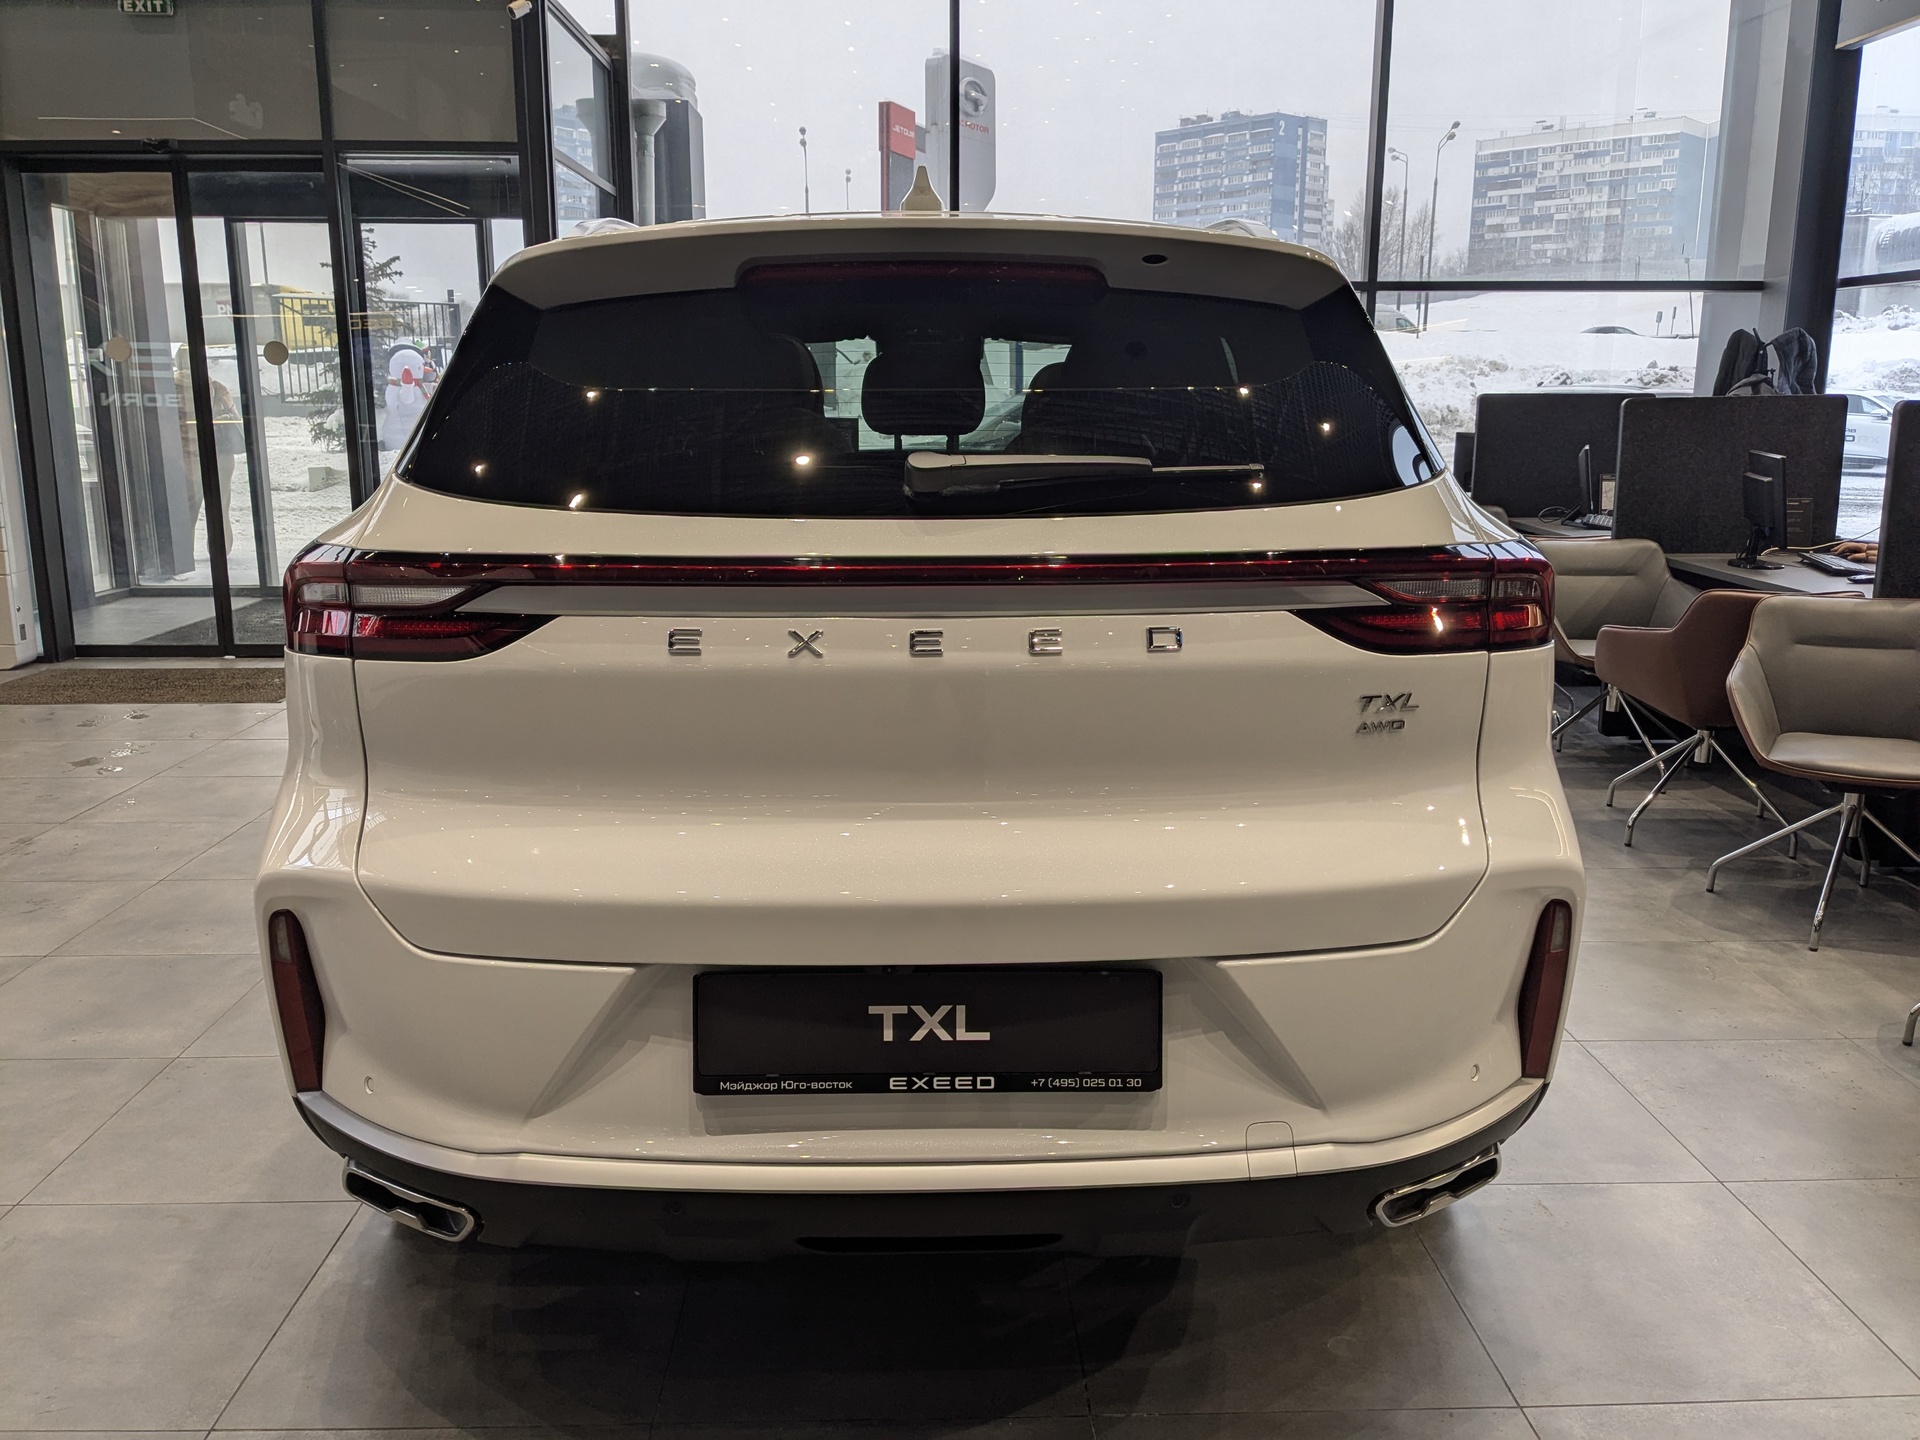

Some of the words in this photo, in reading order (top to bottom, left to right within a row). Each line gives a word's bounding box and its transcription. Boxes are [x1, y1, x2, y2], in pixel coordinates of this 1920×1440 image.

[123, 0, 163, 12] EXIT
[892, 124, 915, 139] JETOUR
[1279, 120, 1285, 136] 2
[667, 625, 1184, 658] EXEED
[1359, 692, 1420, 714] TXL
[1355, 719, 1406, 734] AWD
[868, 1004, 991, 1042] TXL
[719, 1081, 778, 1091] Мэйджор
[781, 1080, 853, 1090] Юго-восток
[889, 1076, 995, 1090] EXEED
[1031, 1078, 1046, 1087] +7
[1048, 1077, 1080, 1088] (495)
[1083, 1078, 1106, 1087] 025
[1108, 1078, 1123, 1087] 01
[1126, 1078, 1142, 1087] 30
